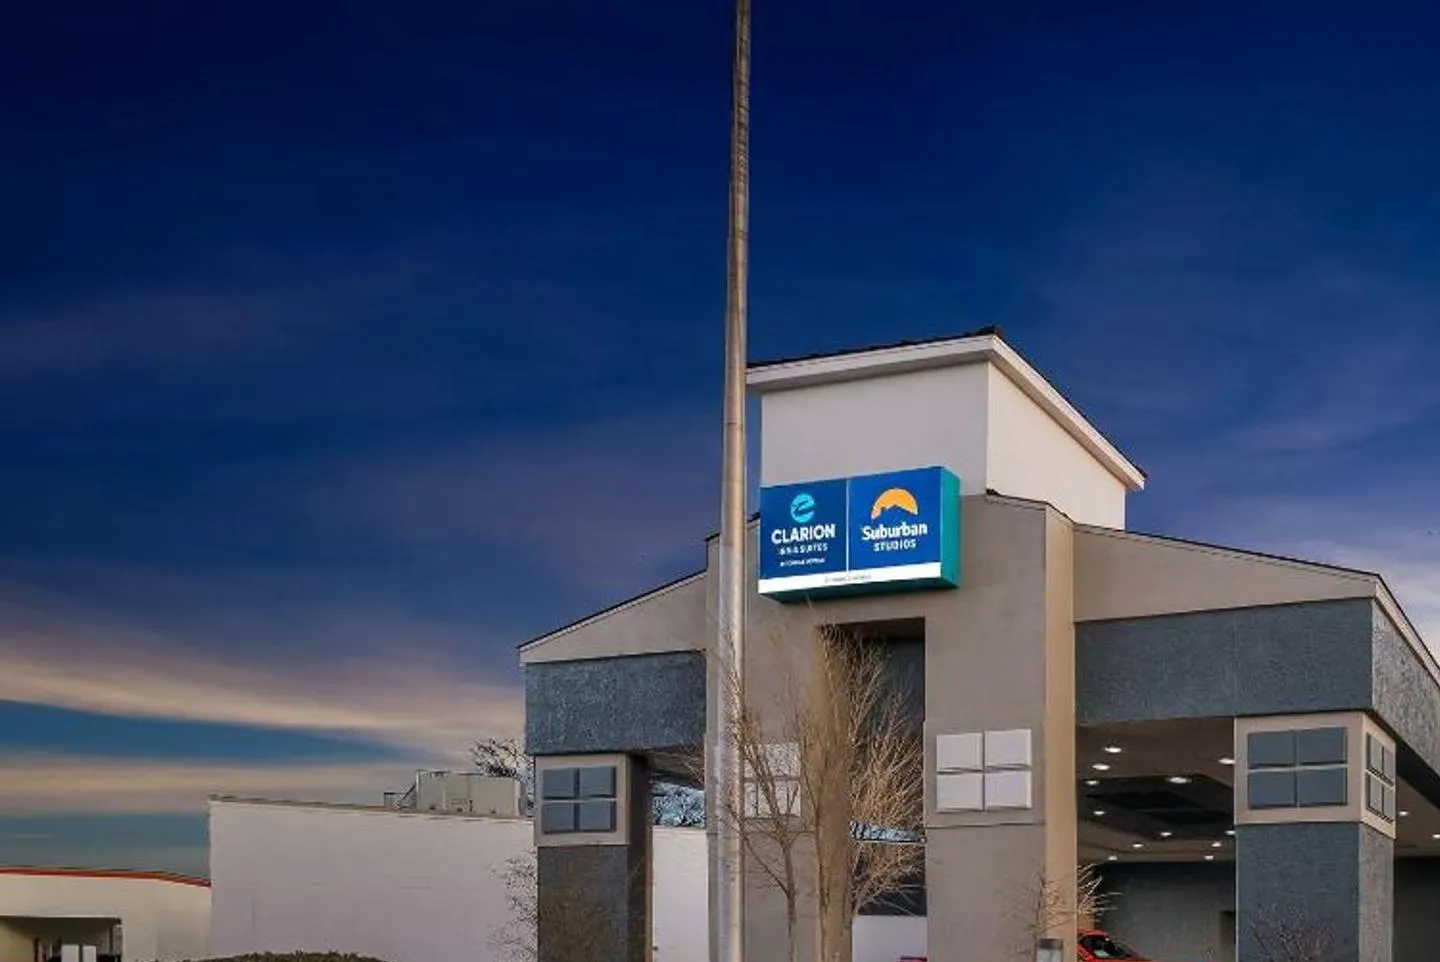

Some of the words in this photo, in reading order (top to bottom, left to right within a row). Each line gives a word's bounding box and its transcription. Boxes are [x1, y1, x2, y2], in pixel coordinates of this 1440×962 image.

[771, 523, 836, 544] CLARION
[861, 521, 928, 541] Suburban
[873, 538, 917, 552] STUDIOS
